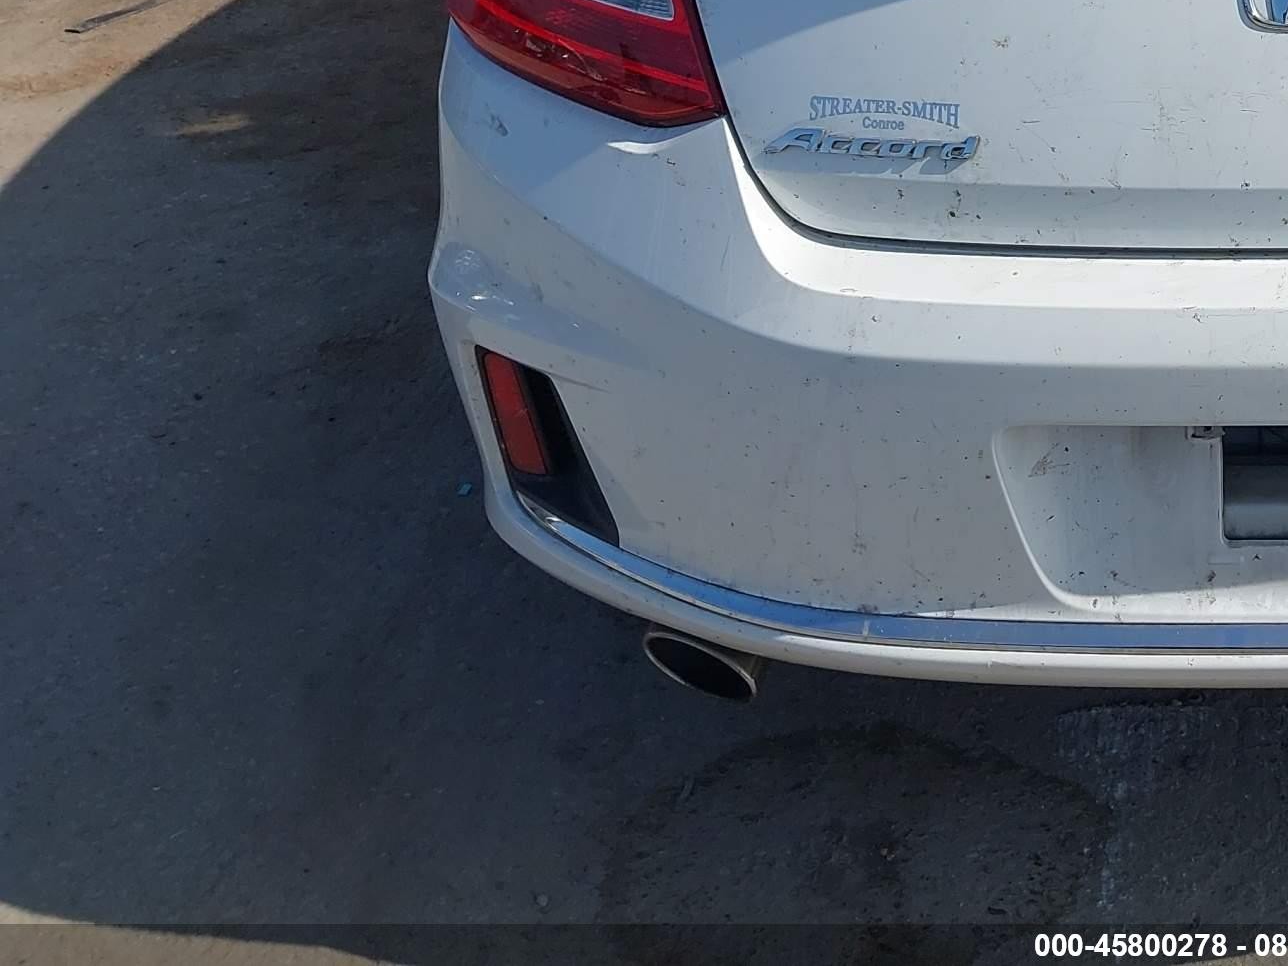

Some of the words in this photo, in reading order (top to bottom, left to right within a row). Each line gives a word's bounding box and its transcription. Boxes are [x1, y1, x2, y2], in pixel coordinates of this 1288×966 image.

[809, 95, 960, 130] STREATER-SMITH
[862, 116, 905, 131] Conroe
[762, 127, 981, 160] Accord
